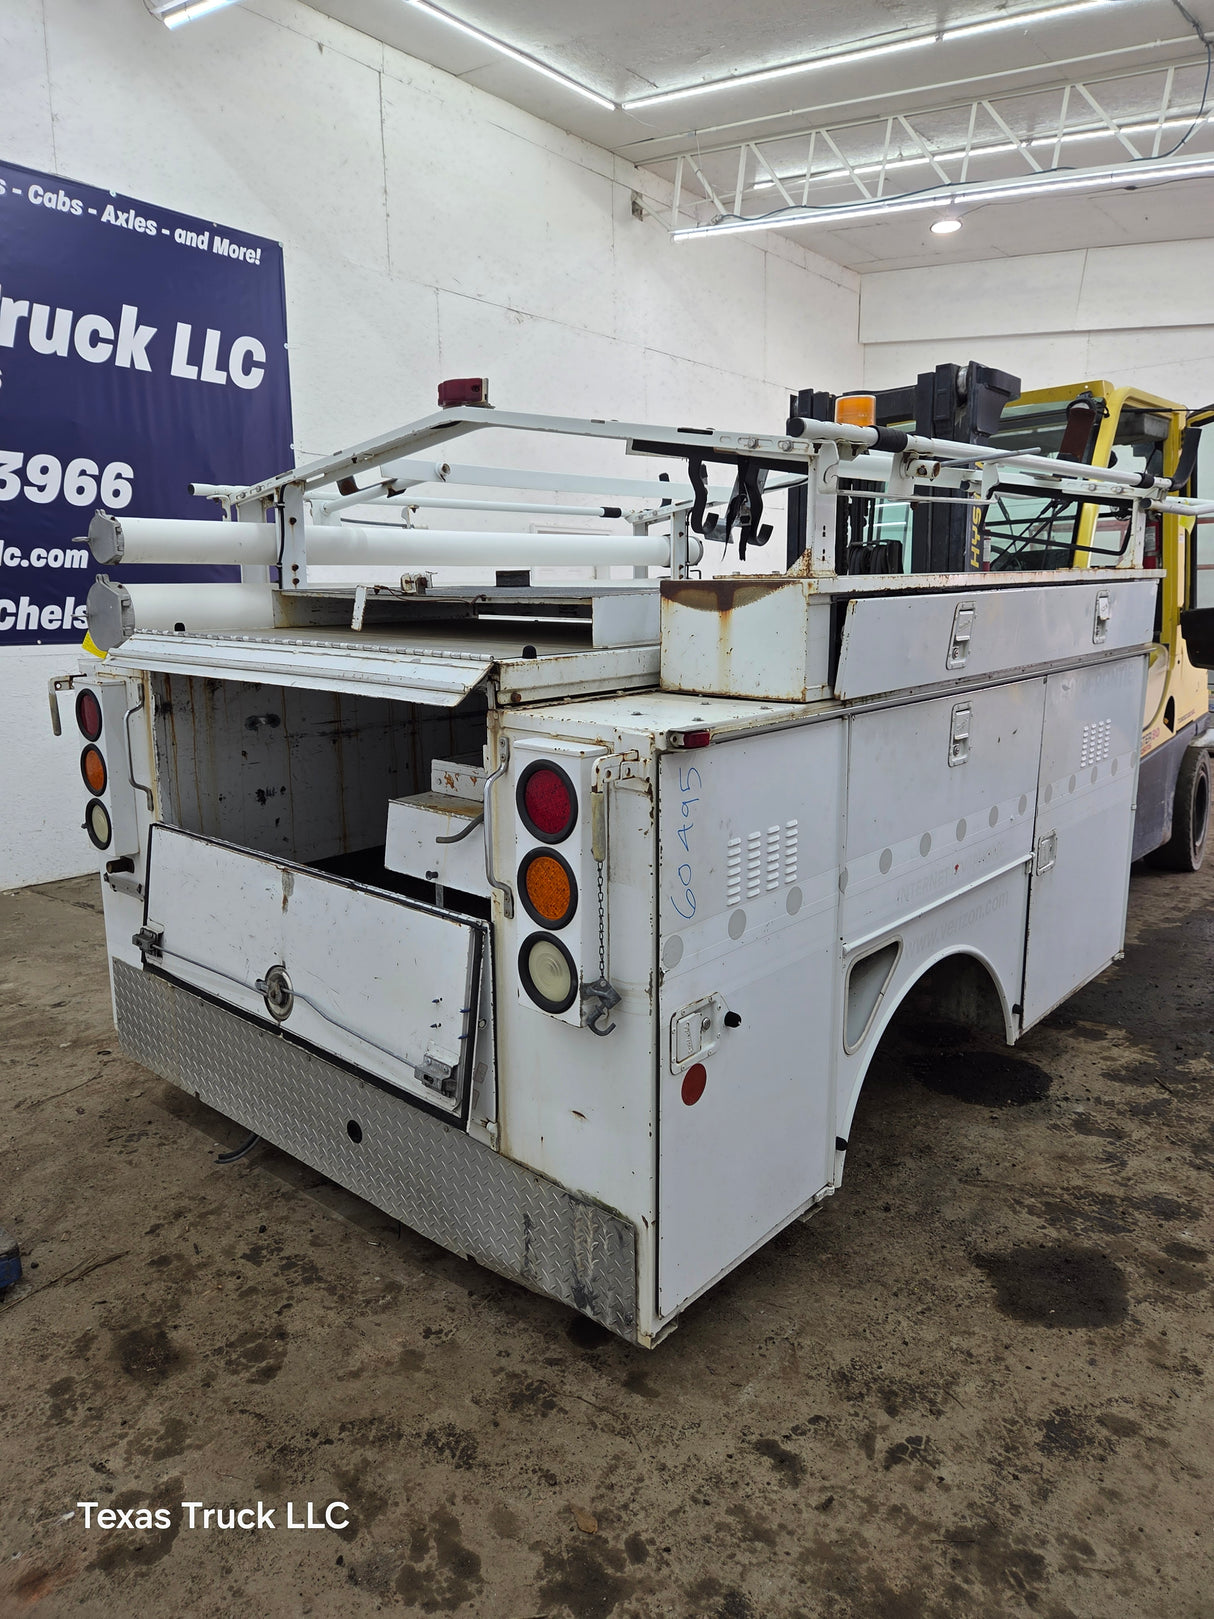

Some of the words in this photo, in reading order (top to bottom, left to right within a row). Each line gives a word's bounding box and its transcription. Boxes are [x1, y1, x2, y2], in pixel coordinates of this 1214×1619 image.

[28, 184, 84, 217] Cabs
[101, 204, 158, 236] Axles
[174, 228, 210, 251] and
[212, 236, 262, 265] More!
[0, 284, 158, 372] ruck
[170, 322, 267, 390] LLC
[0, 450, 135, 509] 3966
